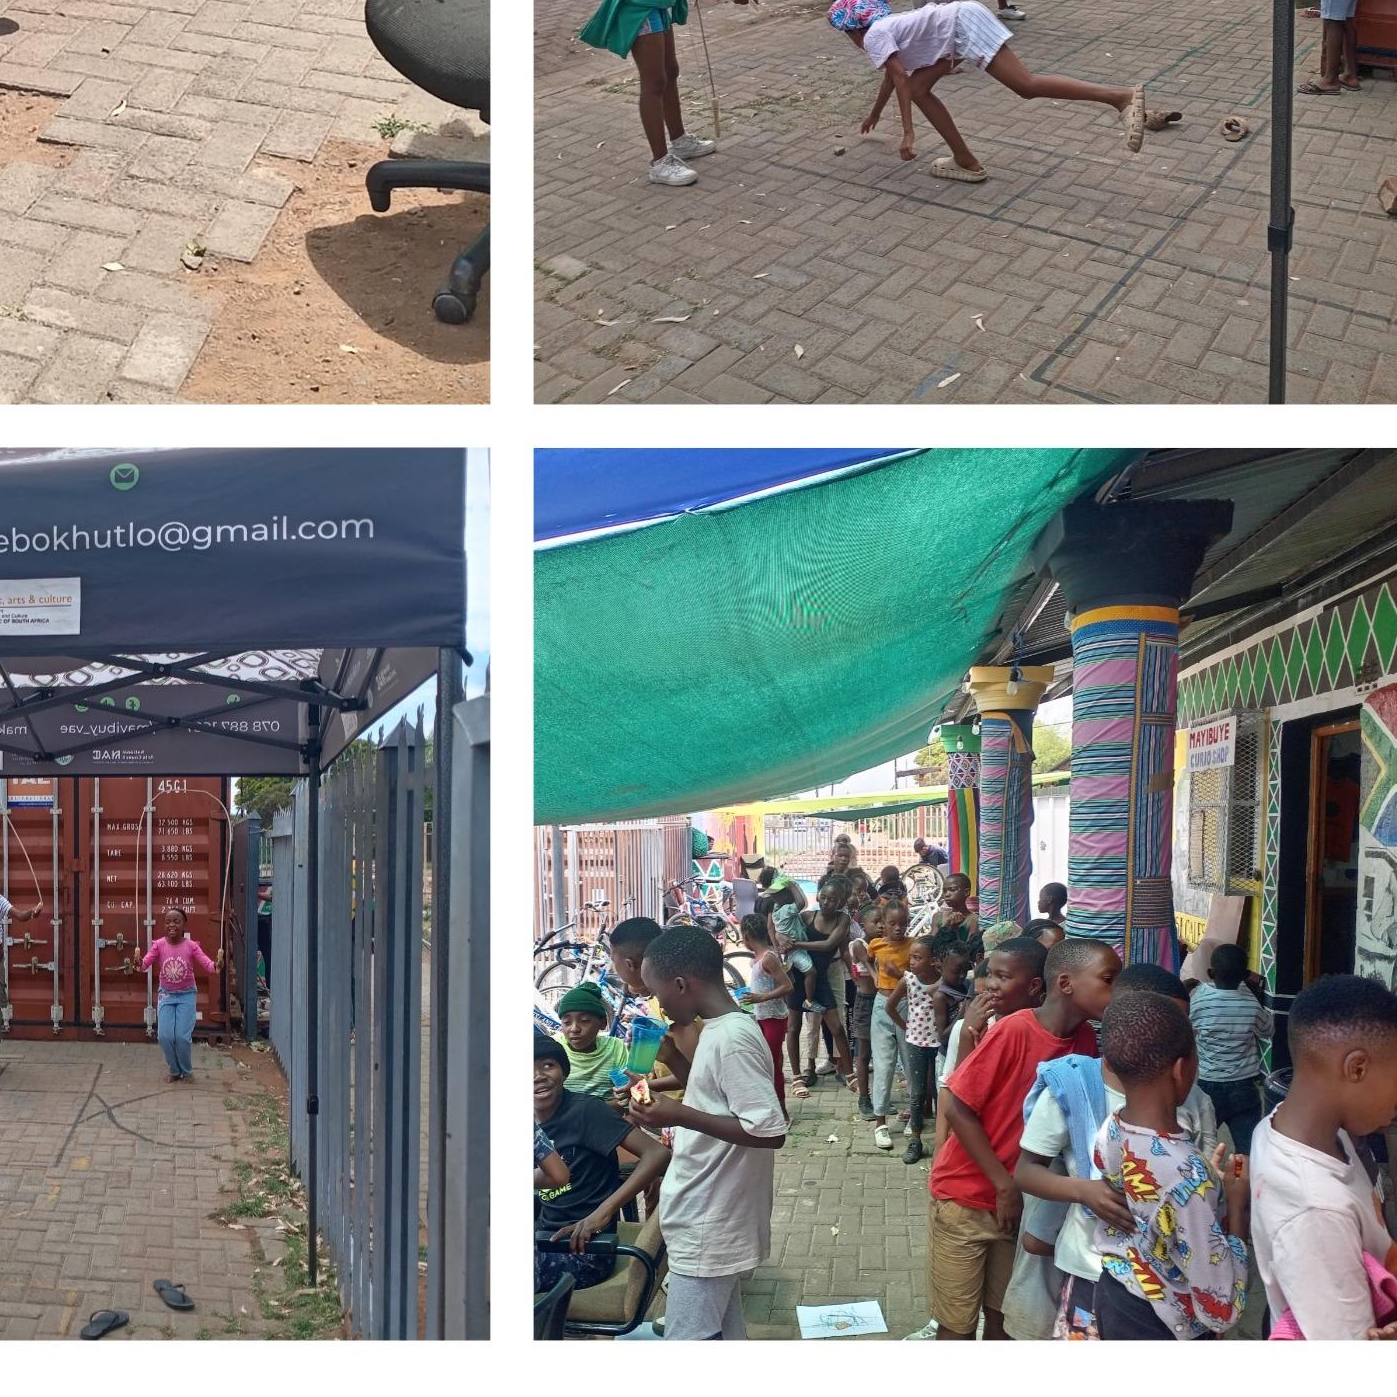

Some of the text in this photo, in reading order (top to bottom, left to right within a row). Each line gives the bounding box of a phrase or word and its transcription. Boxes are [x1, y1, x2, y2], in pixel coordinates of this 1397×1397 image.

[7, 596, 26, 604] arts
[28, 595, 36, 603] &
[38, 594, 73, 604] culture
[1190, 722, 1229, 749] MAYIBUYE
[1190, 745, 1229, 768] CURIO SHOP
[106, 875, 117, 883] NET
